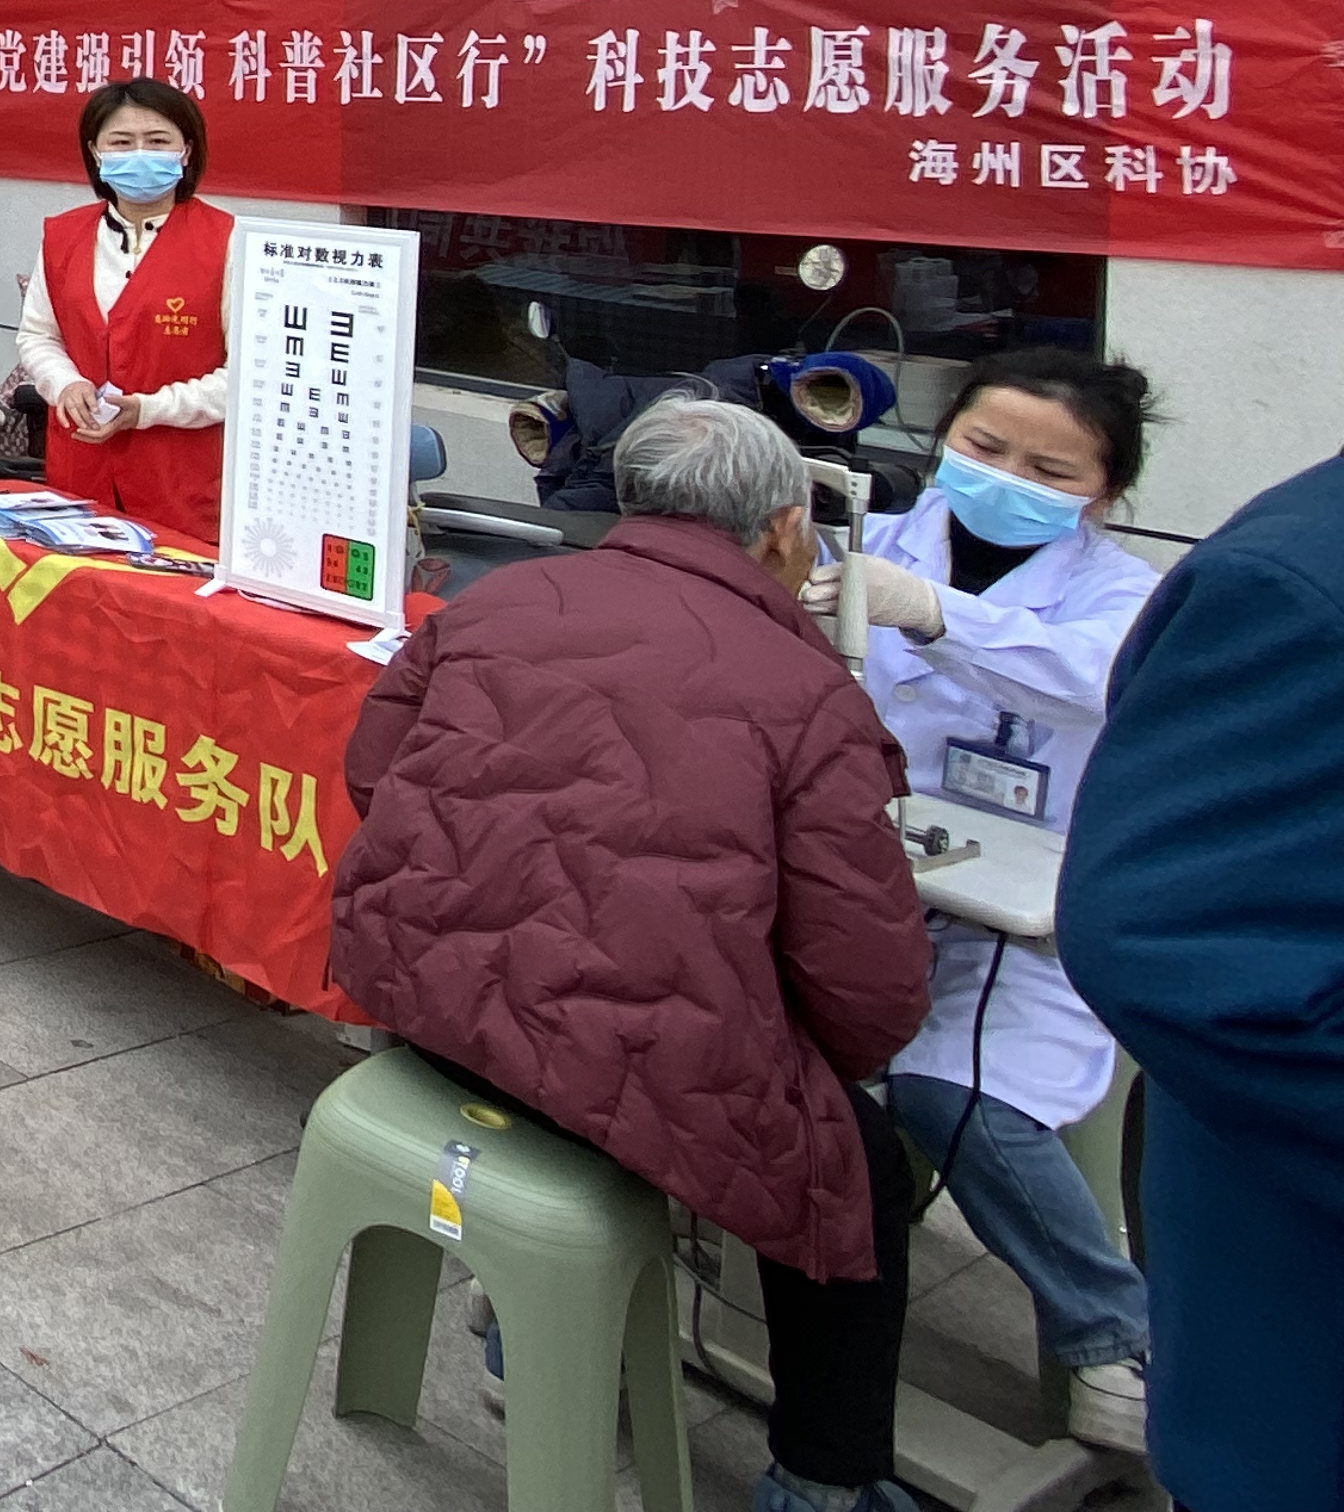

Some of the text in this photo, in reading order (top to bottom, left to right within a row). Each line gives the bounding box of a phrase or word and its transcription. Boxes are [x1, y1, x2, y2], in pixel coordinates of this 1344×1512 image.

[585, 19, 1236, 120] 科技志愿服务活动
[908, 138, 1237, 196] 海州区科协
[263, 241, 384, 269] 标准对数视力表
